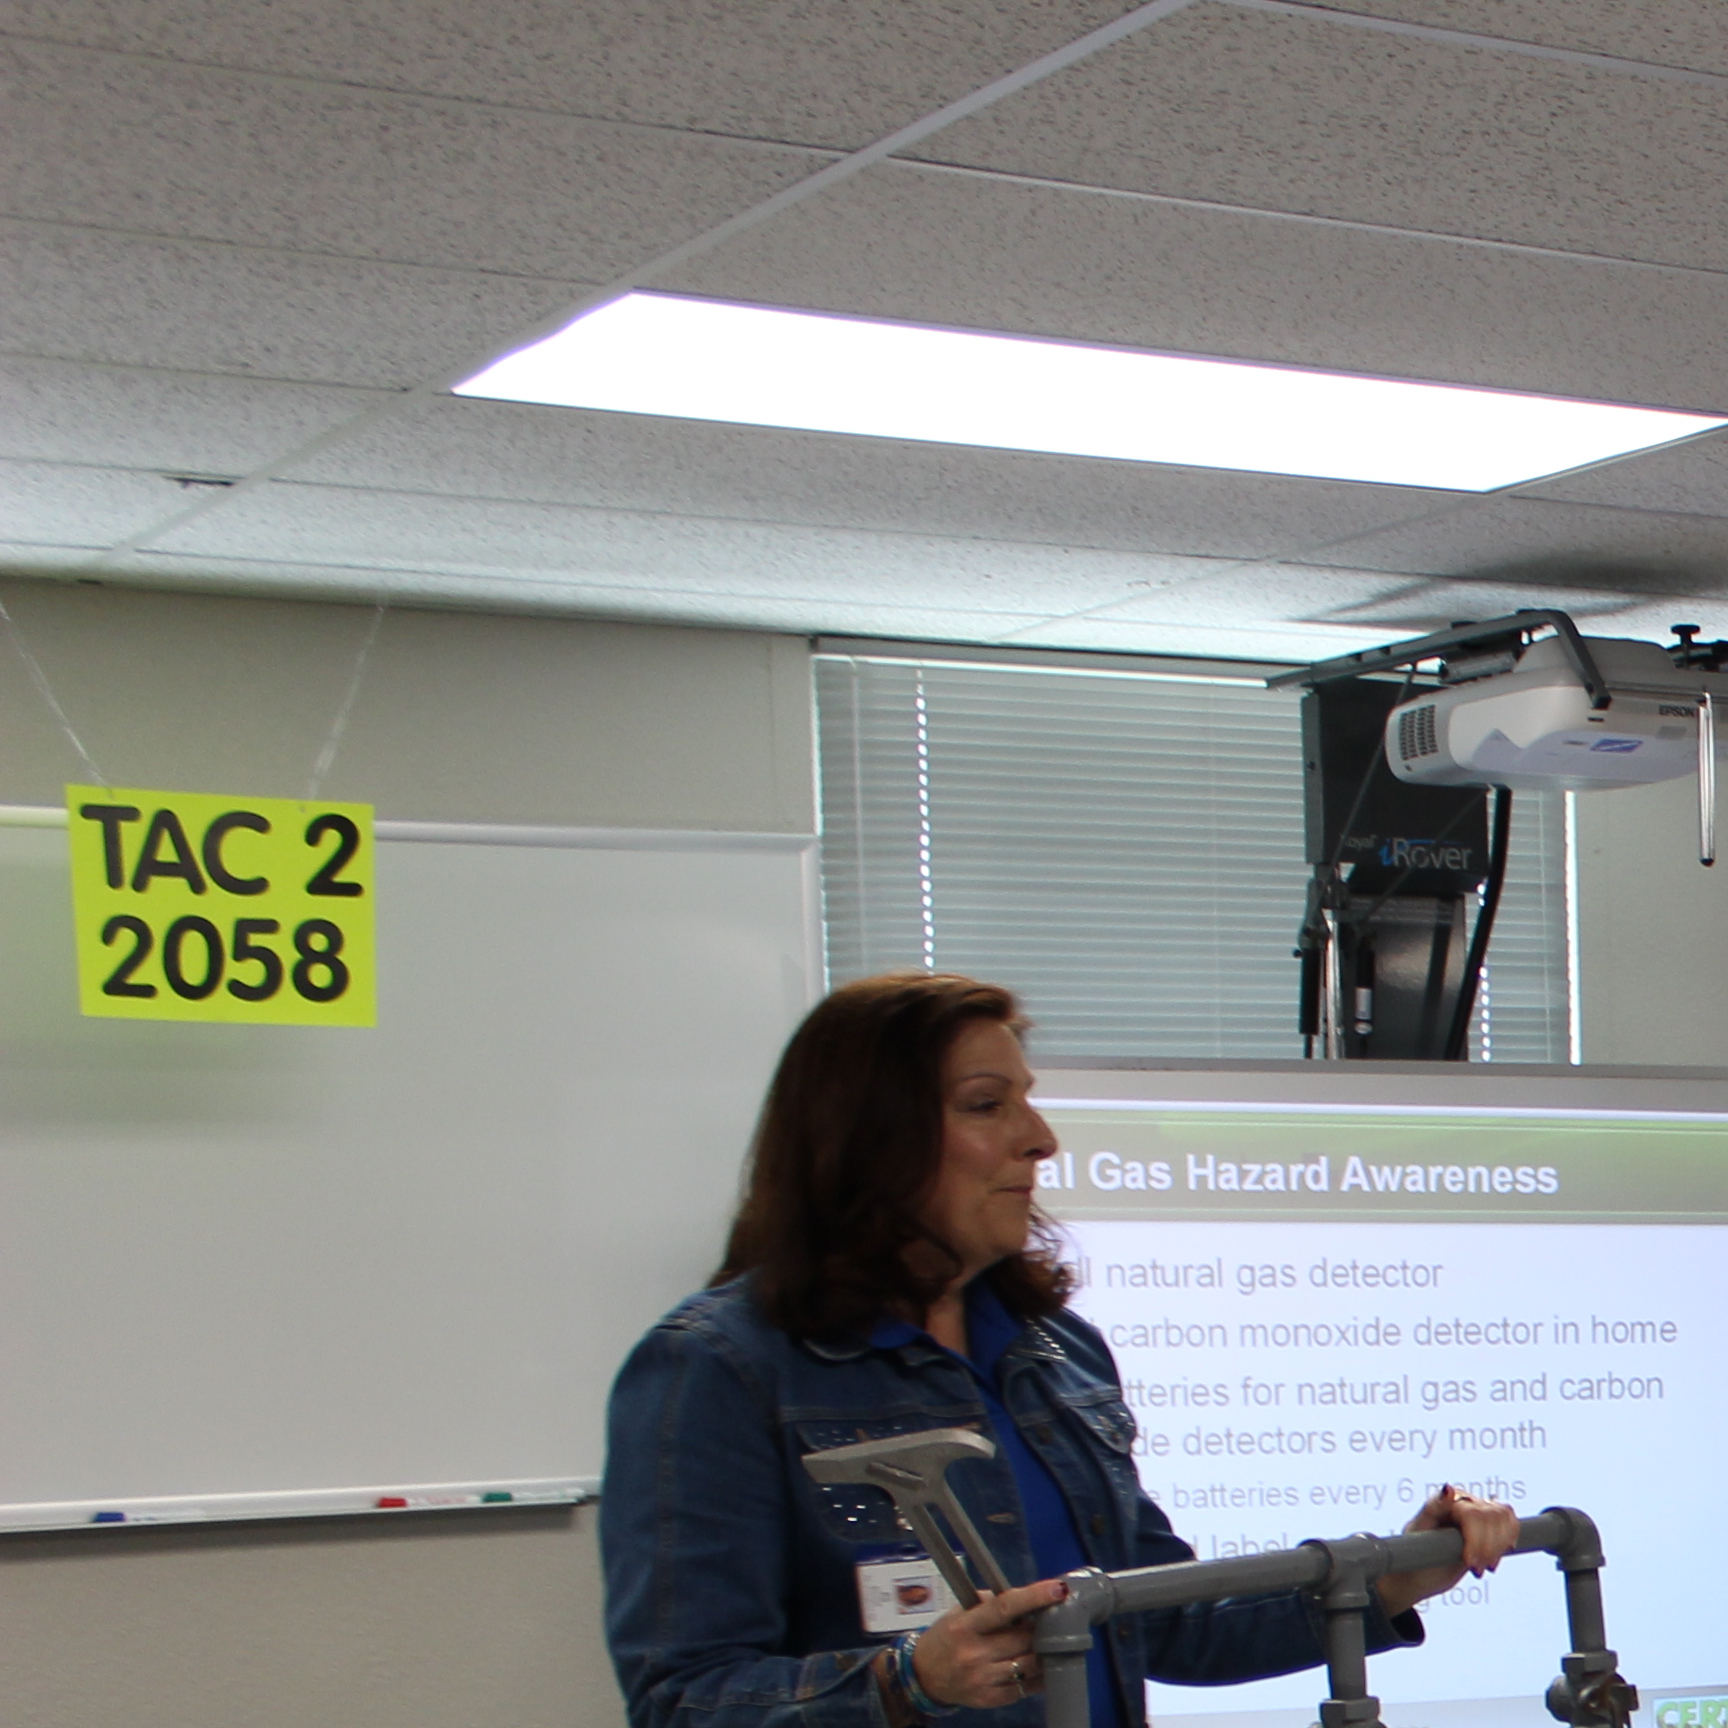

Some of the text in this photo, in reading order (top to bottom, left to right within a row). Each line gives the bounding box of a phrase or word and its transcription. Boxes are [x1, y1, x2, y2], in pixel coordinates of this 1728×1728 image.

[1658, 704, 1695, 718] EPSON
[80, 803, 366, 898] TAC 2
[1378, 836, 1474, 870] iRover
[101, 913, 350, 1005] 2058
[1087, 1151, 1174, 1192] Gas
[1186, 1152, 1331, 1193] Hazard
[1340, 1155, 1560, 1195] Awareness
[1106, 1255, 1224, 1289] natural
[1235, 1263, 1298, 1297] gas
[1308, 1257, 1444, 1289] detector
[1109, 1313, 1679, 1349] carbon monoxide detector in home
[1122, 1370, 1665, 1412] tteries for natural gas and carbon
[1182, 1425, 1338, 1456] detectors
[1348, 1426, 1438, 1459] every
[1449, 1419, 1548, 1451] month
[1172, 1480, 1301, 1510] batteries
[1308, 1482, 1388, 1512] every
[1397, 1477, 1415, 1503] 6
